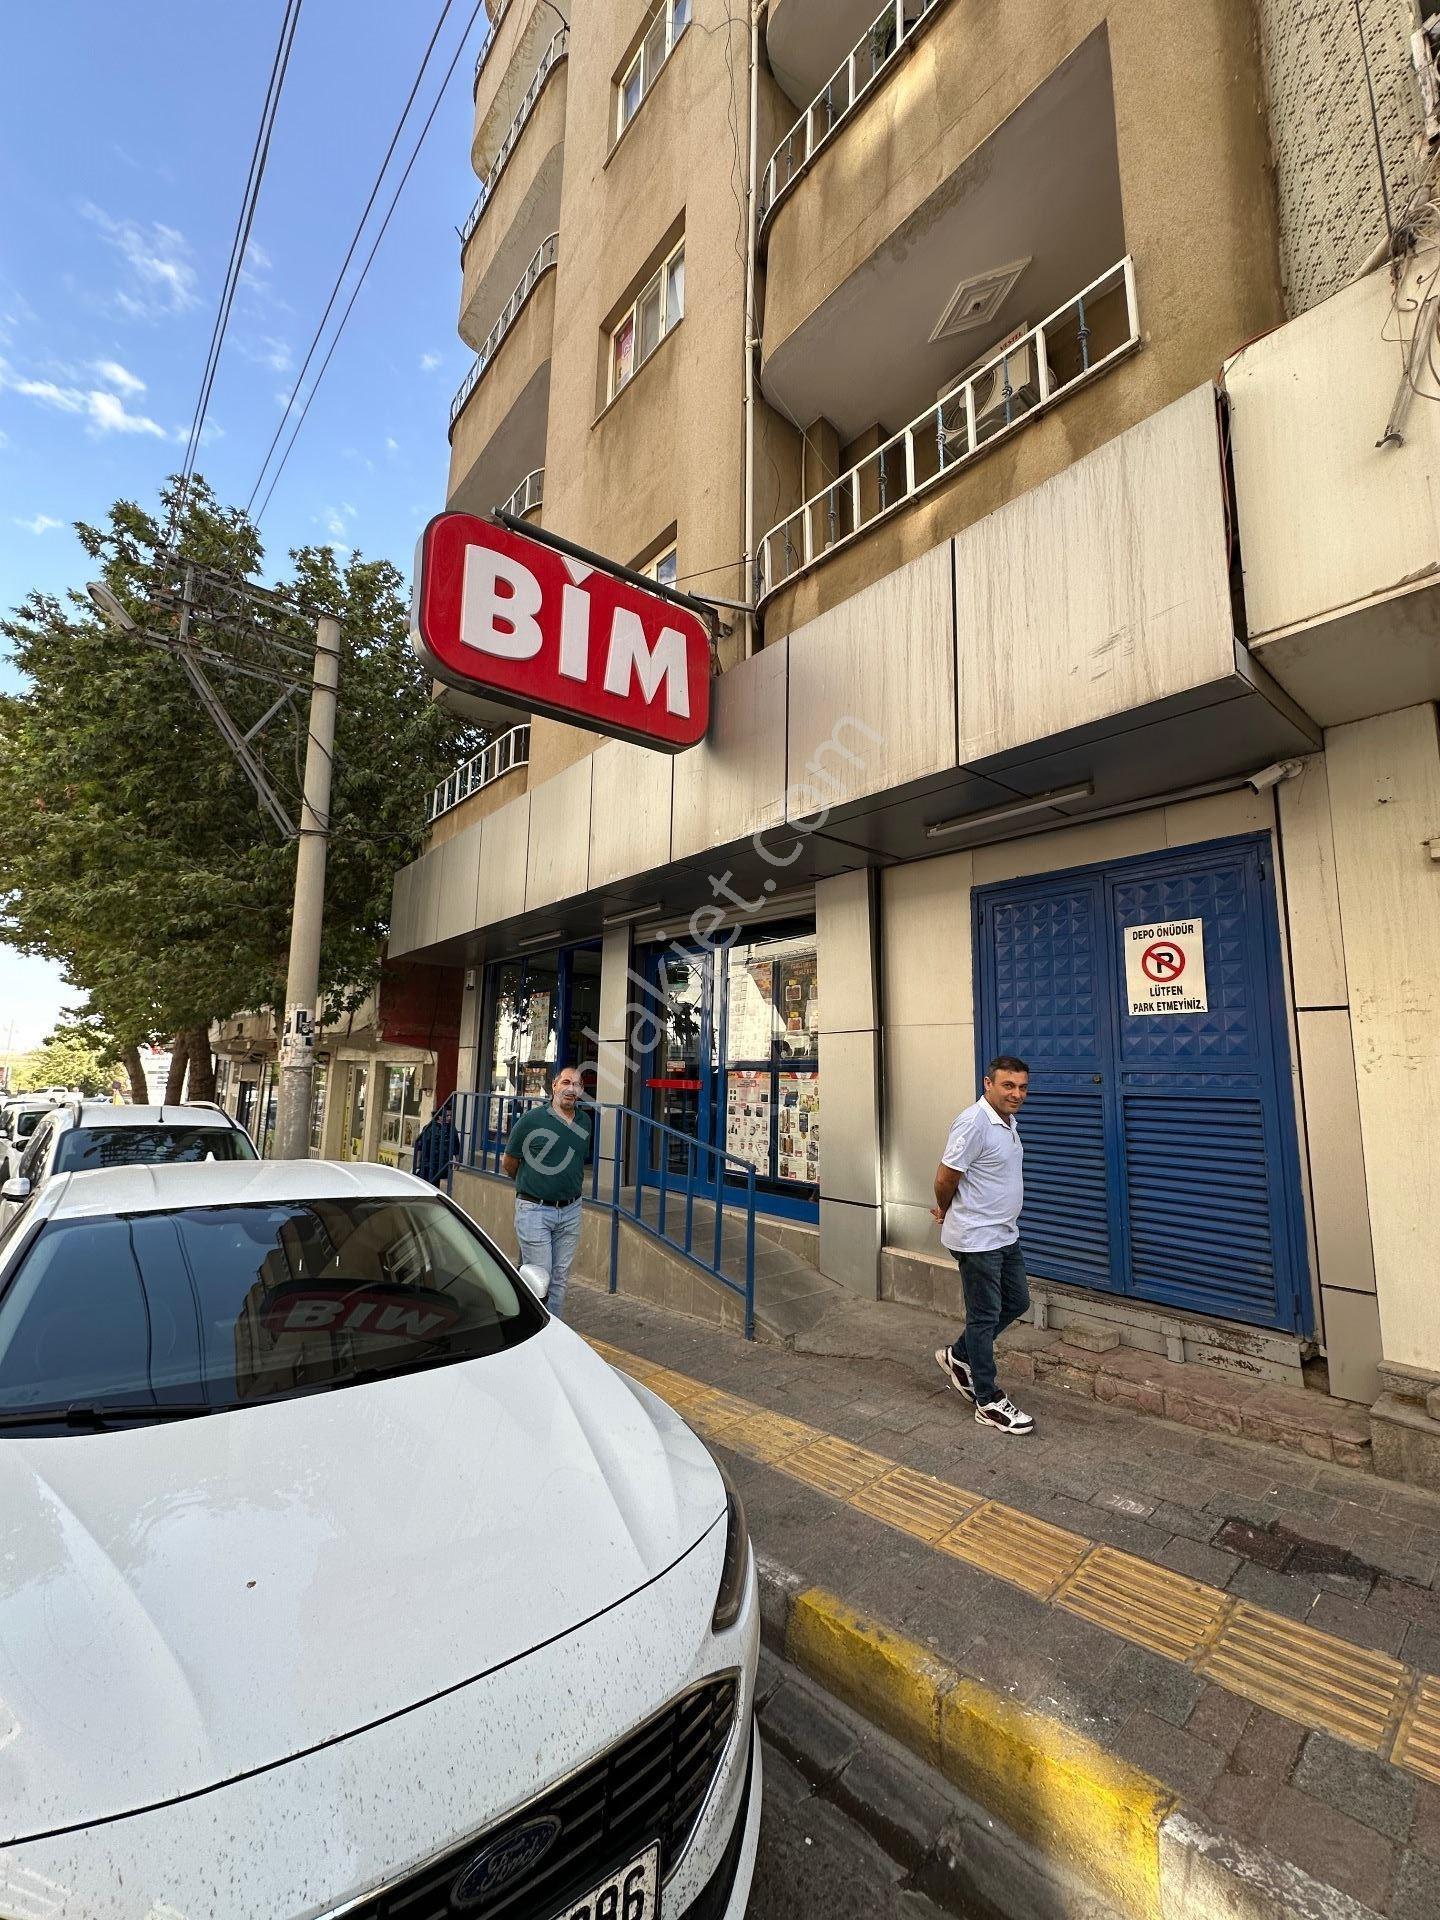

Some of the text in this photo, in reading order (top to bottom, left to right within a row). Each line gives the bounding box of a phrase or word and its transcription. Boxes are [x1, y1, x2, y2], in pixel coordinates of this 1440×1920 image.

[1132, 922, 1194, 941] DEPO ÖNÜDÜR
[1149, 984, 1183, 997] LÜTFEN
[1133, 1002, 1155, 1013] PARK
